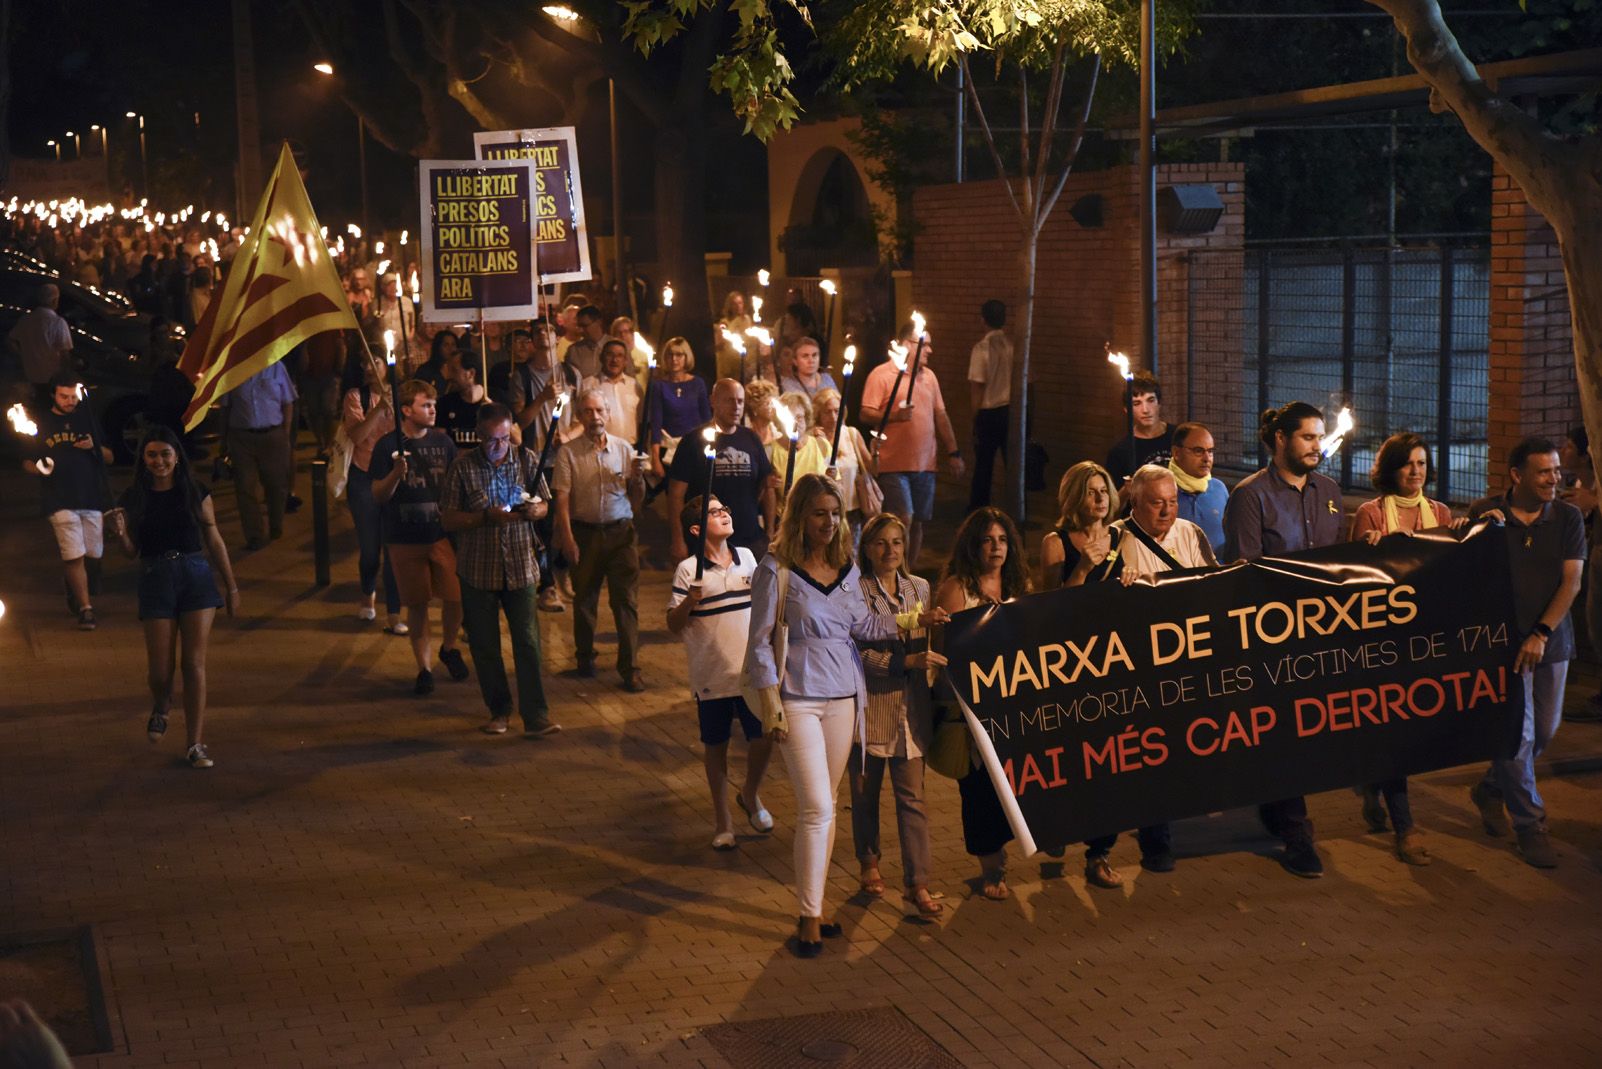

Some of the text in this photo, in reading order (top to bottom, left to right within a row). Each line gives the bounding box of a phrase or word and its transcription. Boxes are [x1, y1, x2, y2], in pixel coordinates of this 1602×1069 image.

[437, 174, 518, 197] LLIBERTAT
[438, 200, 500, 222] PRESOS
[439, 223, 510, 248] POLÍTICS
[440, 250, 518, 273] CATALANS
[440, 278, 472, 298] ARA
[969, 584, 1418, 704] MARXA DE TORXES
[1020, 685, 1151, 736] MEMÒRIA
[1159, 675, 1197, 706] DE
[1206, 665, 1254, 698] LES
[1263, 640, 1399, 686] VÍCTIMES
[1409, 632, 1447, 662] DE
[1457, 622, 1509, 653] 1714
[1082, 724, 1169, 781] MÉS
[1186, 705, 1277, 757] CAP
[1294, 665, 1508, 738] DERROTA!
